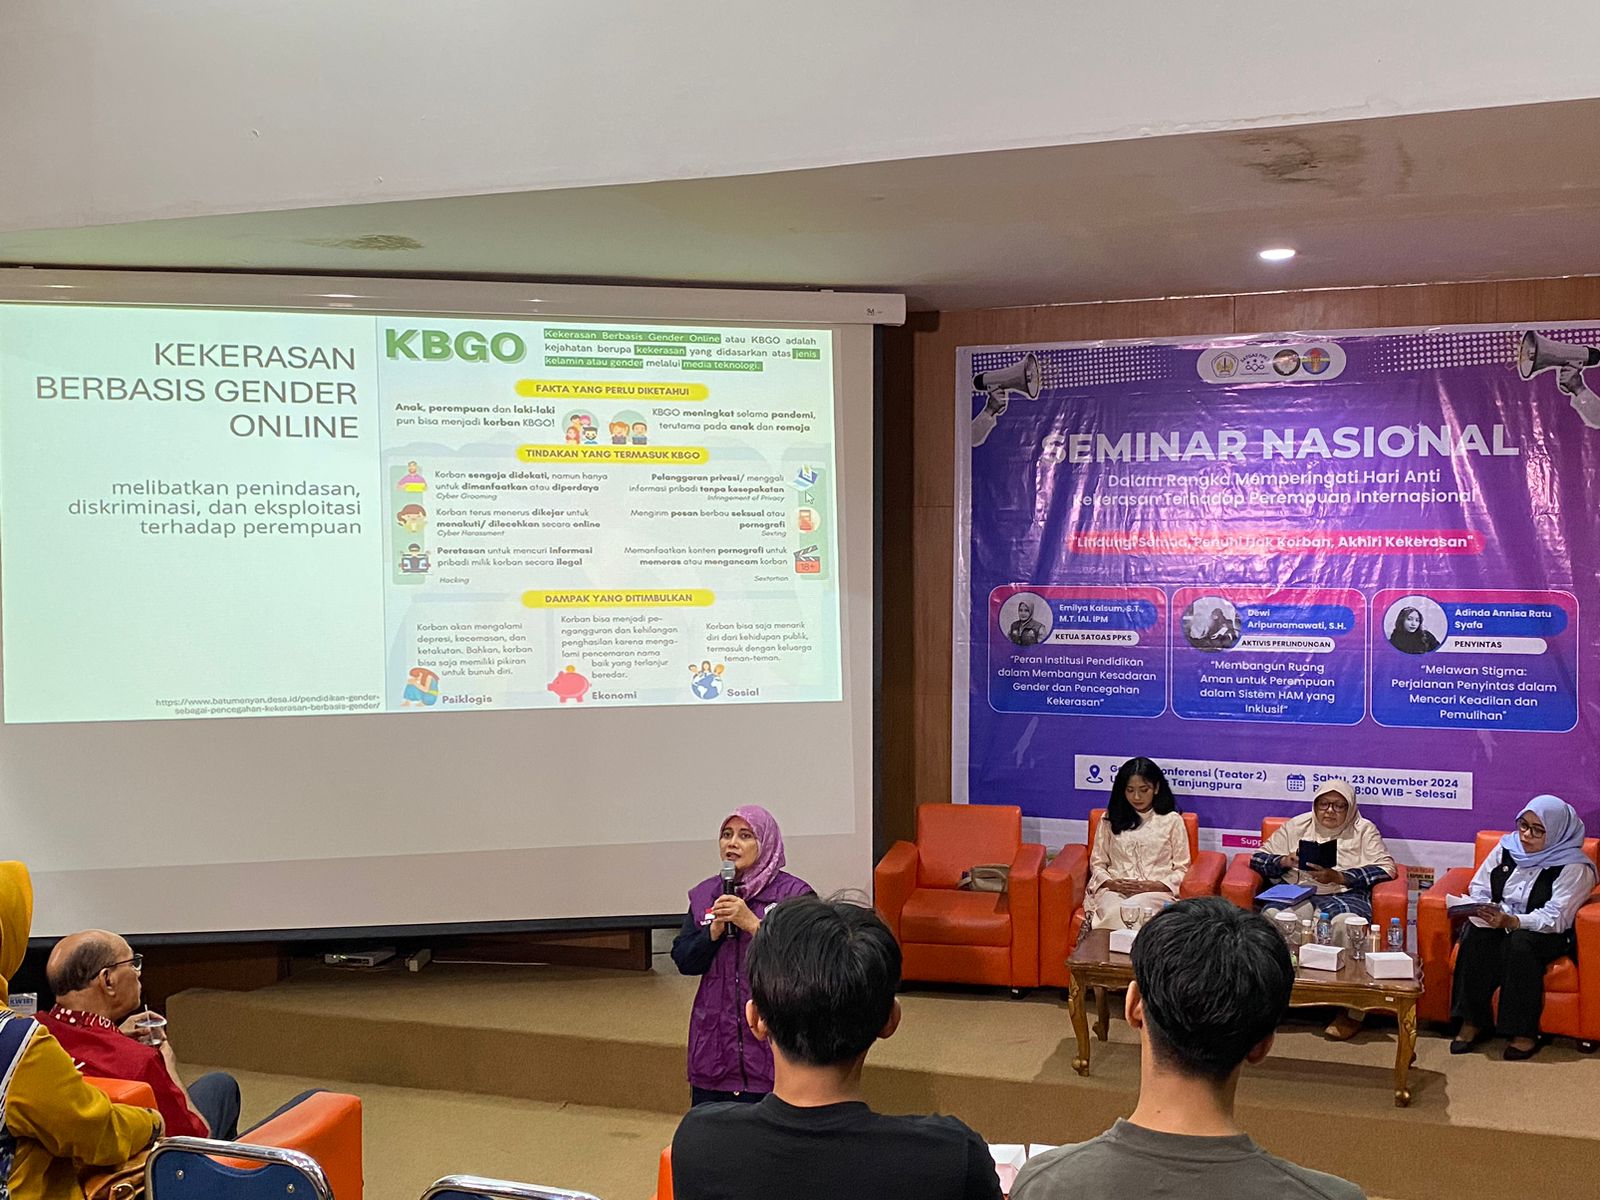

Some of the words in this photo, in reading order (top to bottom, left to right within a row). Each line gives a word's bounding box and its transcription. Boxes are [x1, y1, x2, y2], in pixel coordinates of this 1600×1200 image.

[544, 330, 597, 340] Kekerasan
[601, 332, 643, 341] Berbasis
[647, 333, 684, 342] Gender
[689, 334, 720, 344] Online
[725, 336, 746, 344] atau
[751, 336, 781, 345] KBGO
[785, 337, 817, 346] adalah
[385, 328, 528, 364] KBGO
[544, 343, 593, 353] kejahatan
[597, 344, 632, 354] berupa
[636, 346, 685, 356] kekerasan
[689, 349, 712, 357] yang
[716, 348, 768, 357] didasarkan
[771, 350, 791, 358] atas
[795, 350, 817, 359] jenis
[154, 342, 356, 371] KEKERASAN
[545, 356, 585, 366] kelamin
[586, 358, 609, 367] atau
[609, 359, 642, 368] gender
[645, 359, 681, 368] melalui
[682, 360, 712, 369] media
[714, 361, 761, 371] teknologi.
[36, 376, 206, 402] BERBASIS
[214, 379, 358, 405] GENDER
[535, 384, 570, 393] FAKTA
[572, 385, 603, 394] YANG
[605, 386, 635, 395] PERLU
[637, 387, 690, 396] DIKETAHUI
[395, 403, 427, 412] Anak,
[429, 403, 490, 414] perempuan
[492, 405, 512, 413] dan
[513, 405, 555, 414] laki-laki
[652, 408, 681, 417] KBGO
[683, 409, 735, 419] meningkat
[736, 410, 769, 419] selama
[771, 410, 816, 421] pandemi,
[229, 413, 359, 439] ONLINE
[396, 418, 416, 426] pun
[417, 416, 439, 426] bisa
[441, 418, 482, 428] menjadi
[483, 418, 521, 427] korban
[522, 418, 555, 427] KBGO!
[659, 422, 701, 430] terutama
[703, 423, 728, 432] pada
[729, 423, 755, 431] anak
[756, 423, 774, 431] dan
[776, 424, 810, 433] remaja
[1041, 430, 1247, 464] SEMINAR
[1262, 424, 1520, 460] NASIONAL
[526, 449, 579, 458] TINDAKAN
[581, 450, 611, 458] YANG
[615, 451, 669, 459] TERMASUK
[671, 451, 701, 460] KBGO
[651, 474, 709, 482] Pelanggaran
[710, 473, 745, 482] privasi/
[746, 474, 784, 484] menggali
[1108, 474, 1163, 487] Dalam
[1166, 474, 1231, 489] Rangka
[1235, 473, 1359, 488] Memperingati
[1363, 470, 1400, 484] Hari
[1404, 469, 1441, 483] Anti
[112, 480, 229, 496] melibatkan
[236, 480, 361, 500] penindasan,
[435, 483, 460, 491] untuk
[461, 483, 528, 491] dimanfaatkan
[551, 484, 600, 494] diperdaya
[1164, 492, 1245, 508] Terhadap
[1249, 492, 1351, 507] Perempuan
[1356, 489, 1476, 503] Internasional
[67, 500, 201, 518] diskriminasi,
[208, 500, 247, 516] dan
[254, 500, 362, 520] eksploitasi
[140, 519, 236, 538] terhadap
[243, 521, 362, 539] perempuan
[1277, 536, 1335, 548] Korban,
[1338, 536, 1382, 548] Akhiri
[1385, 535, 1473, 548] Kekerasan"
[545, 595, 590, 604] DAMPAK
[593, 595, 623, 603] YANG
[625, 594, 693, 602] DITIMBULKAN
[1059, 604, 1088, 614] Emilya
[1089, 604, 1125, 614] Kalsum,
[1247, 609, 1270, 617] Dewi
[1455, 608, 1490, 617] Adinda
[1492, 609, 1527, 618] Annisa
[1528, 609, 1552, 618] Ratu
[1059, 614, 1076, 623] M.T.
[1093, 615, 1109, 623] IPM
[474, 622, 523, 632] mengalami
[1247, 621, 1327, 630] Aripurnamawati,
[1328, 622, 1347, 630] S.H.
[1455, 620, 1483, 631] Syafa
[1055, 633, 1080, 641] KETUA
[1081, 633, 1111, 642] SATGAS
[1112, 634, 1132, 642] PPKS
[1272, 640, 1331, 648] PERLINDUNGAN
[1454, 640, 1502, 649] PENYINTAS
[1044, 656, 1084, 666] Institusi
[1086, 657, 1144, 667] Pendidikan
[1288, 662, 1325, 674] Ruang
[997, 667, 1030, 677] dalam
[1032, 669, 1097, 681] Membangun
[1100, 671, 1157, 681] Kesadaran
[1481, 665, 1528, 678] Stigma:
[1200, 675, 1233, 684] Aman
[1236, 676, 1268, 685] untuk
[1269, 676, 1335, 689] Perempuan
[1391, 678, 1455, 691] Perjalanan
[1456, 680, 1515, 693] Penyintas
[1517, 681, 1557, 692] dalam
[591, 692, 637, 700] Ekonomi
[727, 688, 760, 697] Sosial
[1012, 682, 1050, 692] Gender
[1051, 683, 1072, 693] dan
[1074, 684, 1140, 697] Pencegahan
[1199, 689, 1236, 699] dalam
[1238, 690, 1276, 699] Sistem
[1278, 691, 1304, 700] HAM
[1305, 692, 1335, 703] yang
[442, 695, 493, 705] Psiklogis
[1409, 693, 1457, 705] Mencari
[1459, 695, 1512, 706] Keadilan
[1514, 696, 1538, 707] dan
[1214, 768, 1254, 780] (Teater
[1256, 770, 1267, 781] 2)
[1352, 774, 1365, 784] 23
[1368, 776, 1428, 787] November
[1430, 778, 1459, 788] 2024
[1172, 778, 1242, 791] Tanjungpura
[1355, 785, 1379, 796] 8:00
[1381, 787, 1404, 797] WIB
[1415, 789, 1457, 799] Selesai
